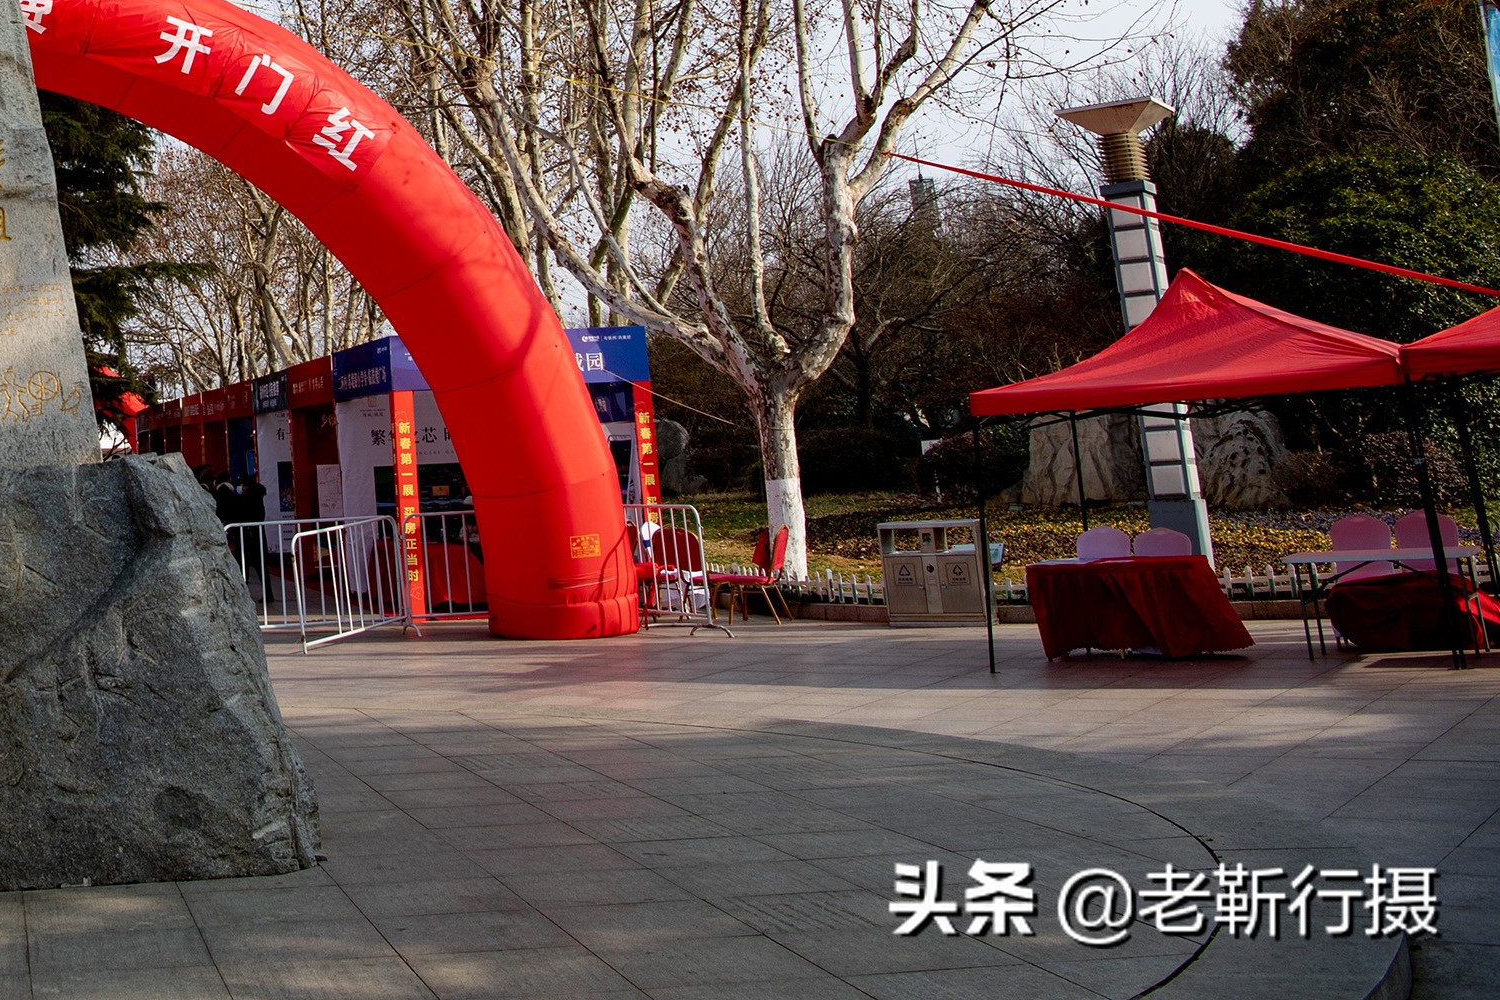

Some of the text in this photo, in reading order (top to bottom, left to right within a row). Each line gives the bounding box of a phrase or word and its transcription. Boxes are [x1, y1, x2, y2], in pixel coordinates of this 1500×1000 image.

[154, 15, 375, 171] 开门红
[398, 422, 414, 496] 新春第一展
[638, 412, 656, 486] 新春第一展
